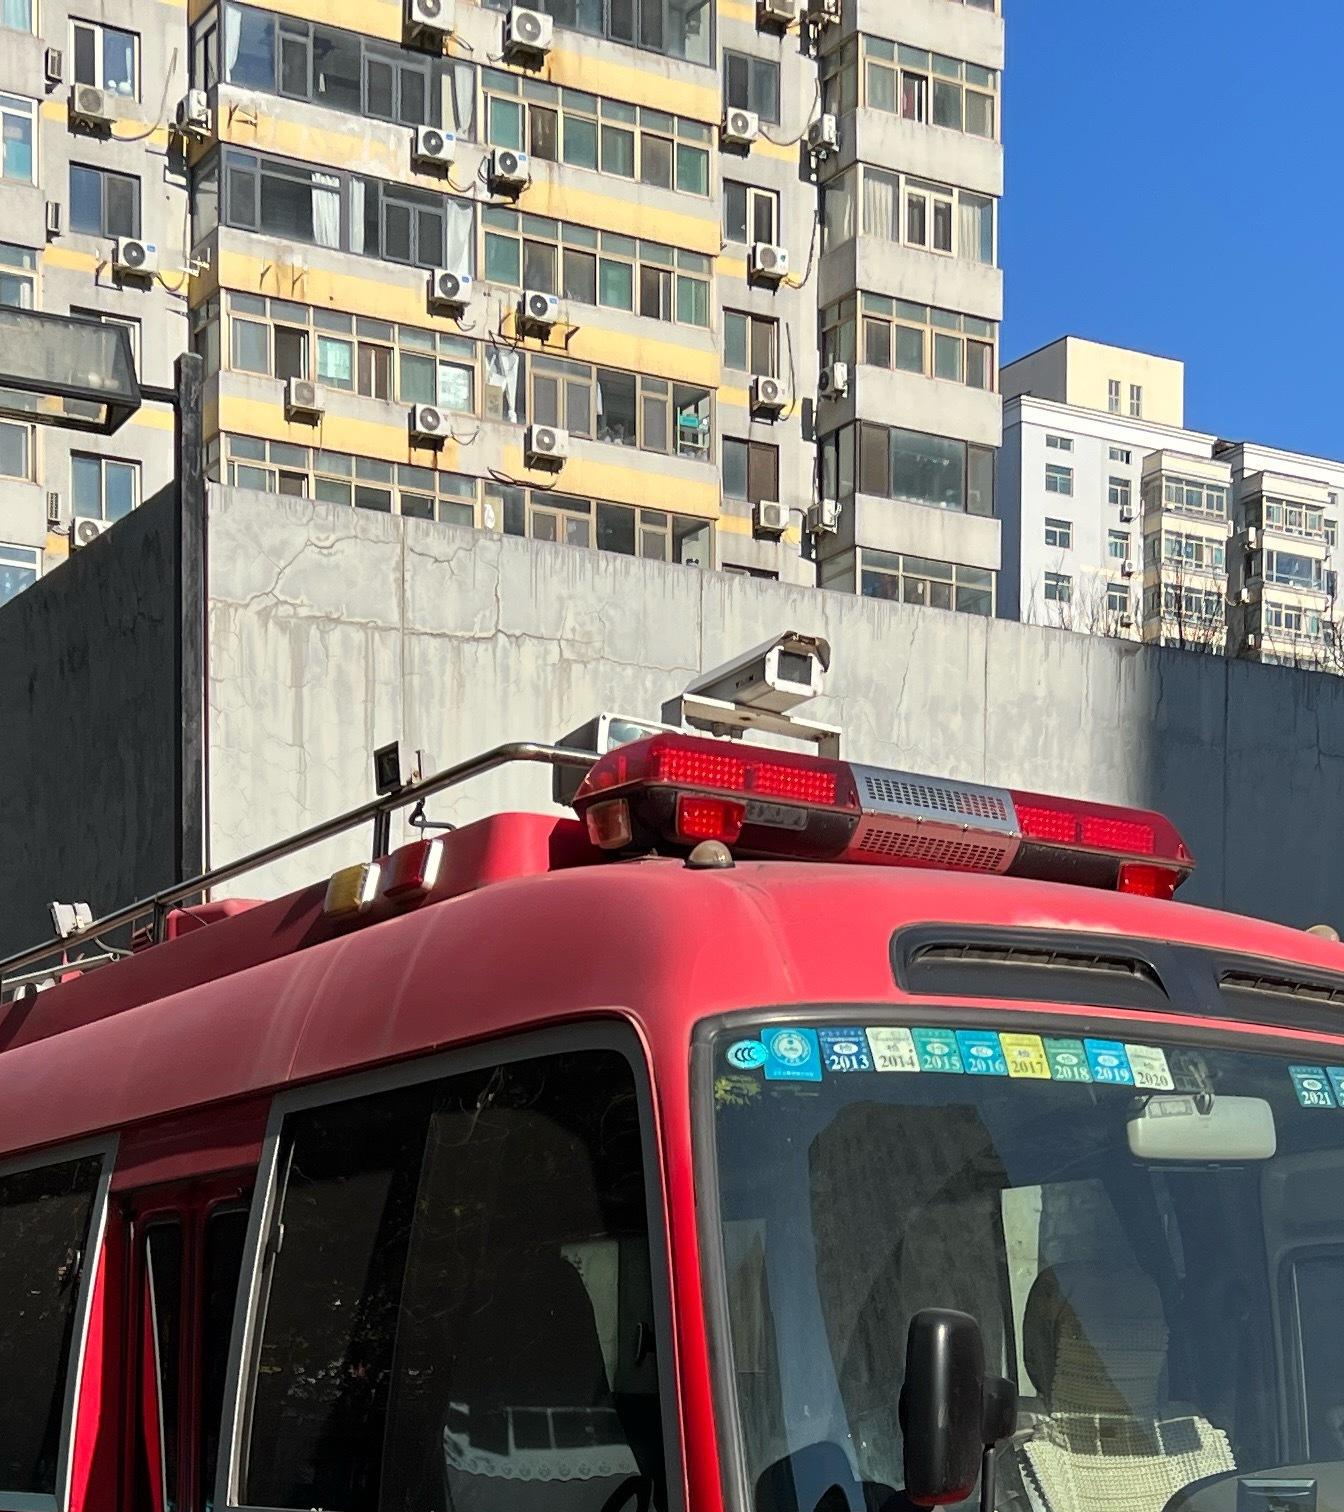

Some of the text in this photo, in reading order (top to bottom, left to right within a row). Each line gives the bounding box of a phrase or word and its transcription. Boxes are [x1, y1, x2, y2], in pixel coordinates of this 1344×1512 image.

[830, 1055, 869, 1070] 2013
[879, 1055, 915, 1069] 2014
[923, 1056, 960, 1070] 2015
[968, 1058, 1004, 1073] 2016
[1011, 1060, 1045, 1074] 2017
[1055, 1065, 1089, 1080] 2018
[1095, 1067, 1129, 1082] 2019
[1138, 1072, 1169, 1087] 2020
[1302, 1091, 1331, 1106] 2021
